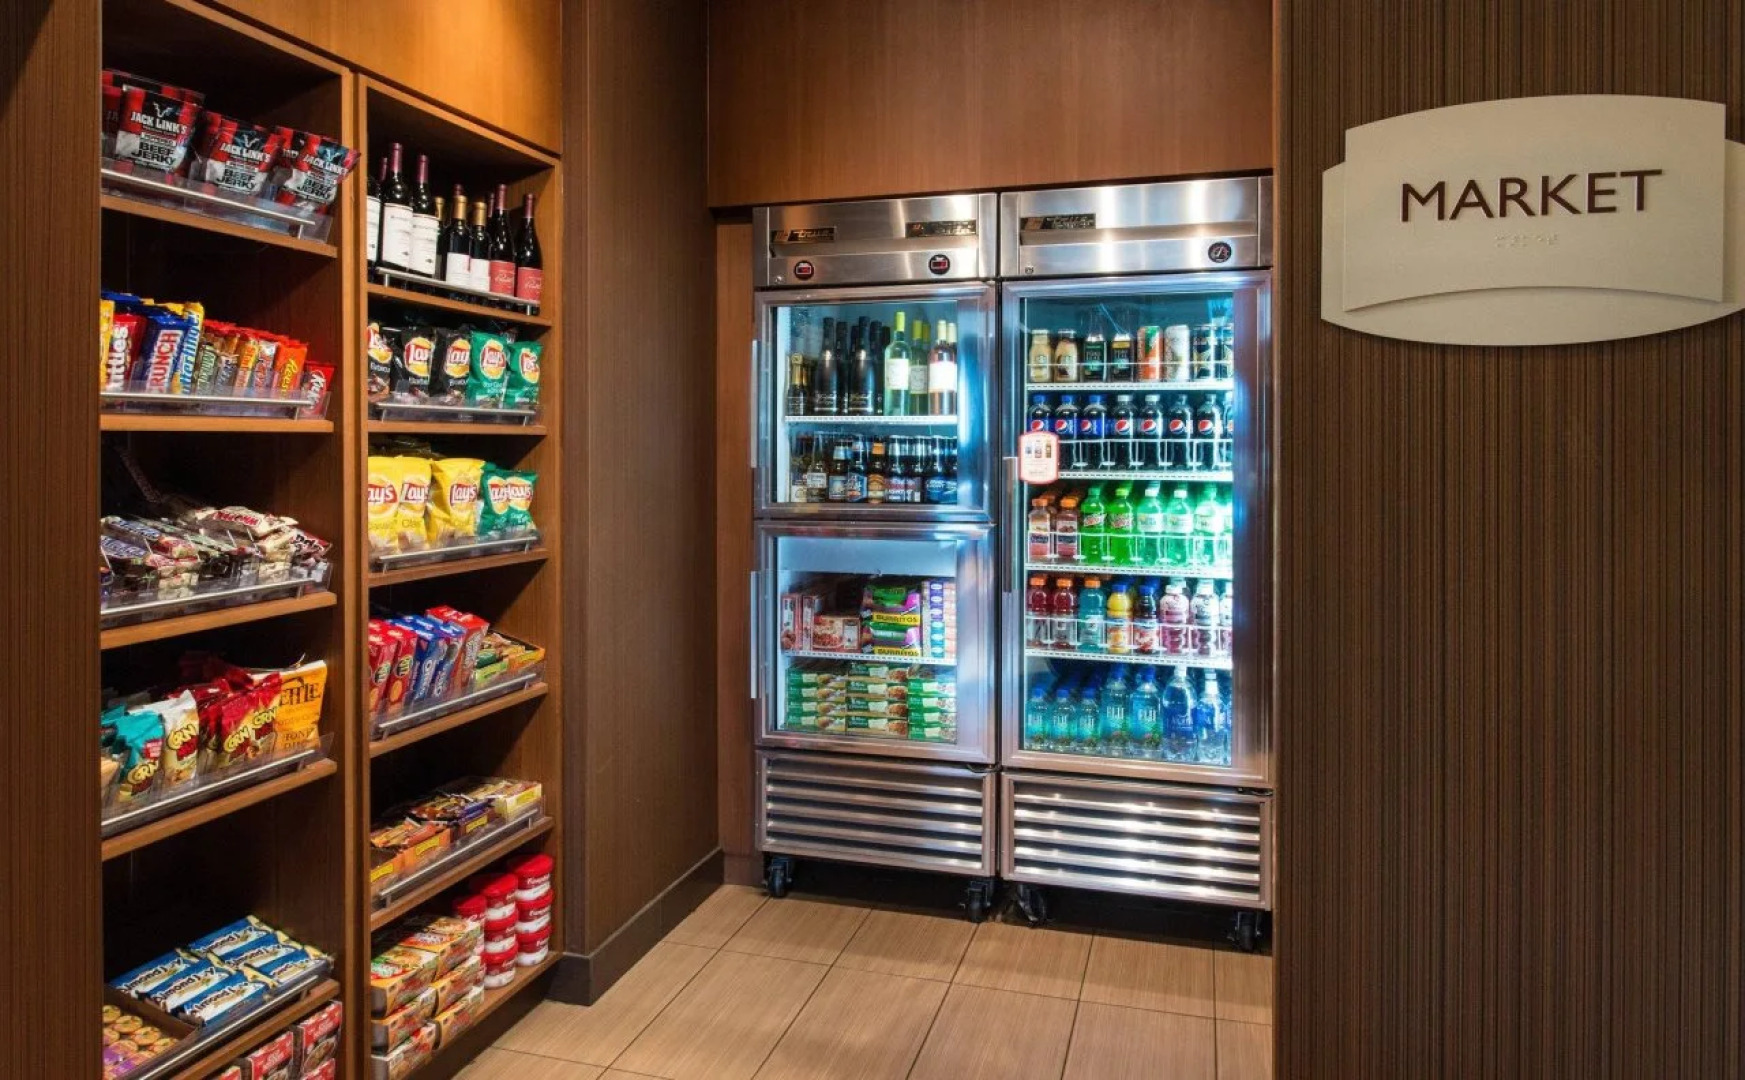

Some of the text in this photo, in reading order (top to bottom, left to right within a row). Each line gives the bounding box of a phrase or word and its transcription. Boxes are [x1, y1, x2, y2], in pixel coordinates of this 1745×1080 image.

[131, 111, 154, 127] JACK
[156, 118, 187, 134] LINK'S
[131, 150, 176, 165] JERKY
[139, 142, 174, 156] BEEF
[220, 142, 241, 155] JACK
[242, 148, 271, 163] LINK'S
[303, 154, 324, 169] JACK
[217, 176, 256, 191] JERKY
[224, 168, 256, 181] BEEF
[1402, 168, 1663, 222] MARKET
[368, 483, 395, 503] ay's
[451, 483, 478, 504] Lay's
[876, 614, 918, 623] BURRITOS
[279, 683, 321, 706] ETTLE
[168, 723, 196, 749] CORN
[153, 976, 196, 1002] Almond
